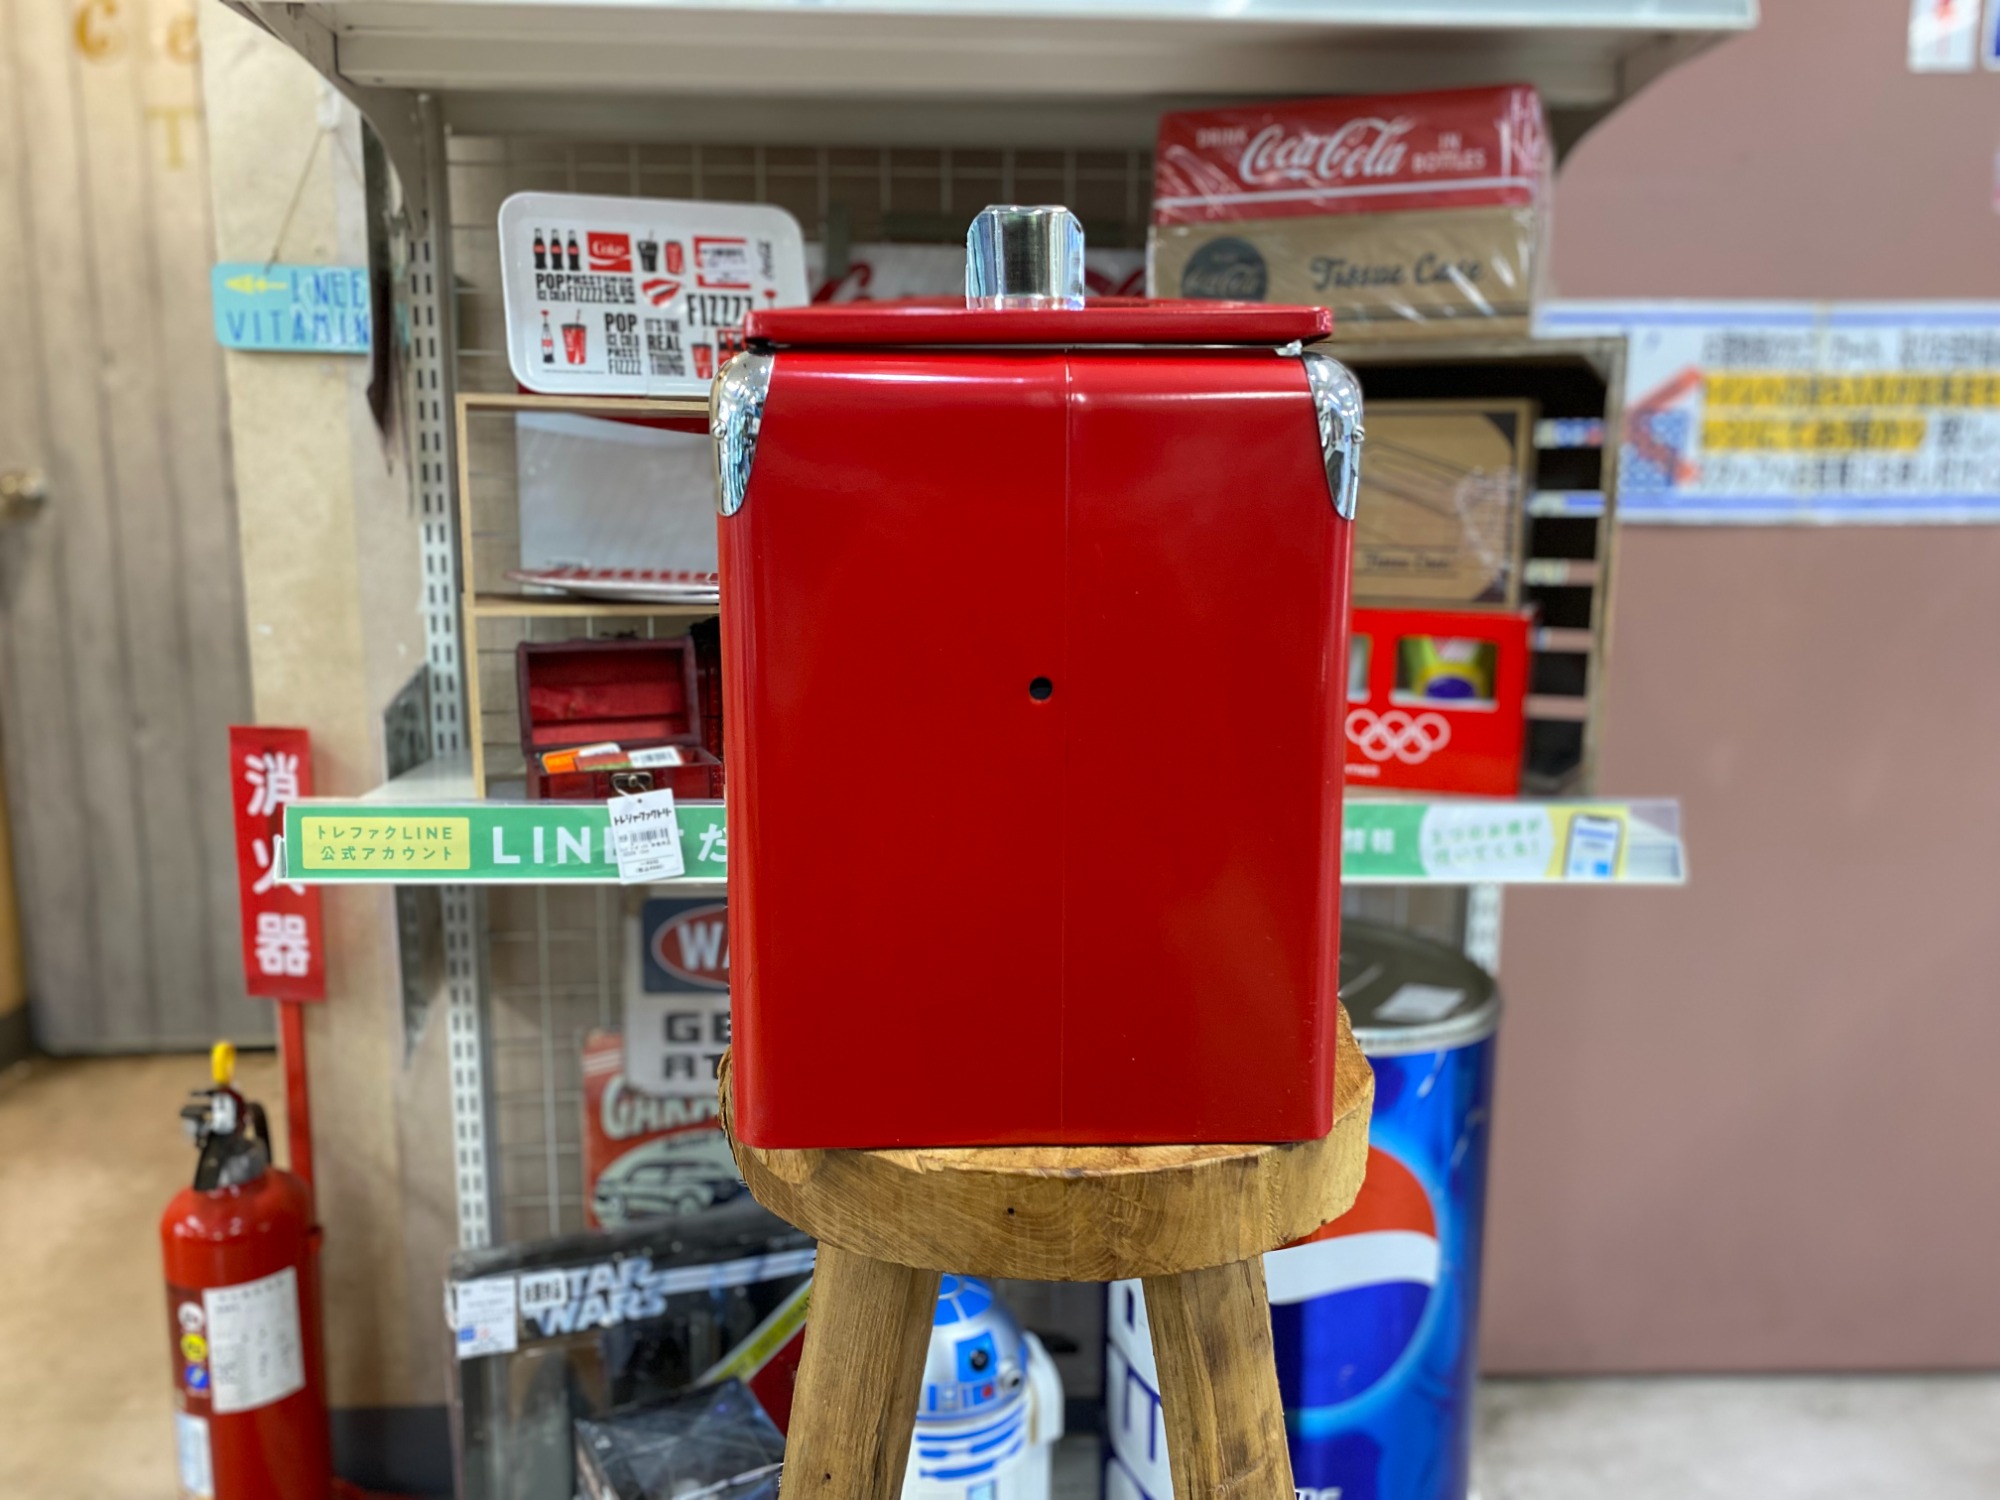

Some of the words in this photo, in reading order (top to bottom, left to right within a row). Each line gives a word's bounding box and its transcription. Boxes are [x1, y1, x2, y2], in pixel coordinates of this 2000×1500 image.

[535, 273, 565, 290] POP
[604, 313, 637, 332] POP
[317, 825, 453, 841] トレファクLINE
[321, 846, 452, 861] 公式アカウント
[676, 920, 731, 970] W
